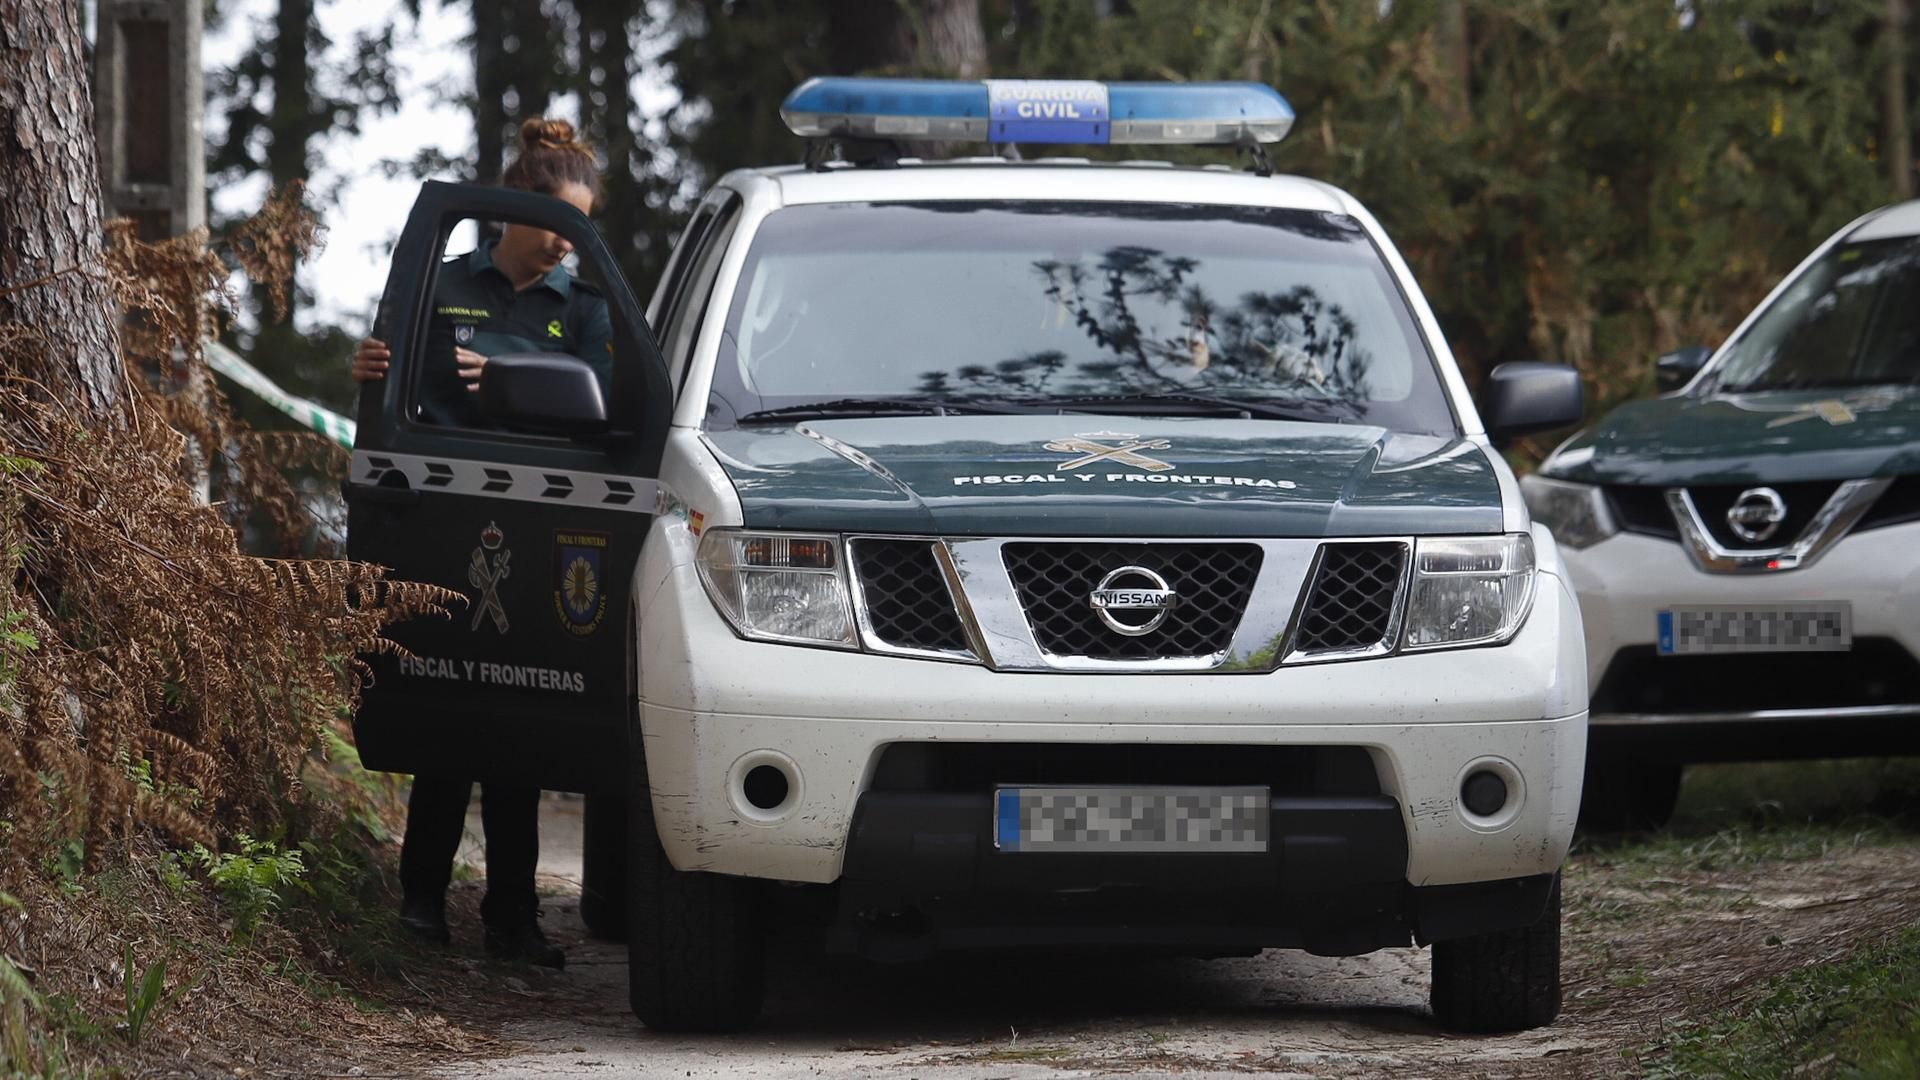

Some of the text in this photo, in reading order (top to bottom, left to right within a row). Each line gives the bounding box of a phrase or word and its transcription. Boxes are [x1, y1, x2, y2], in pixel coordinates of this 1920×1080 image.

[998, 87, 1099, 100] GUARDIA
[1017, 102, 1080, 118] CIVIL
[953, 473, 1297, 489] FISCAL Y FRONTERAS
[1100, 593, 1167, 604] NISSAN
[400, 656, 585, 693] FISCAL Y FRONTERAS
